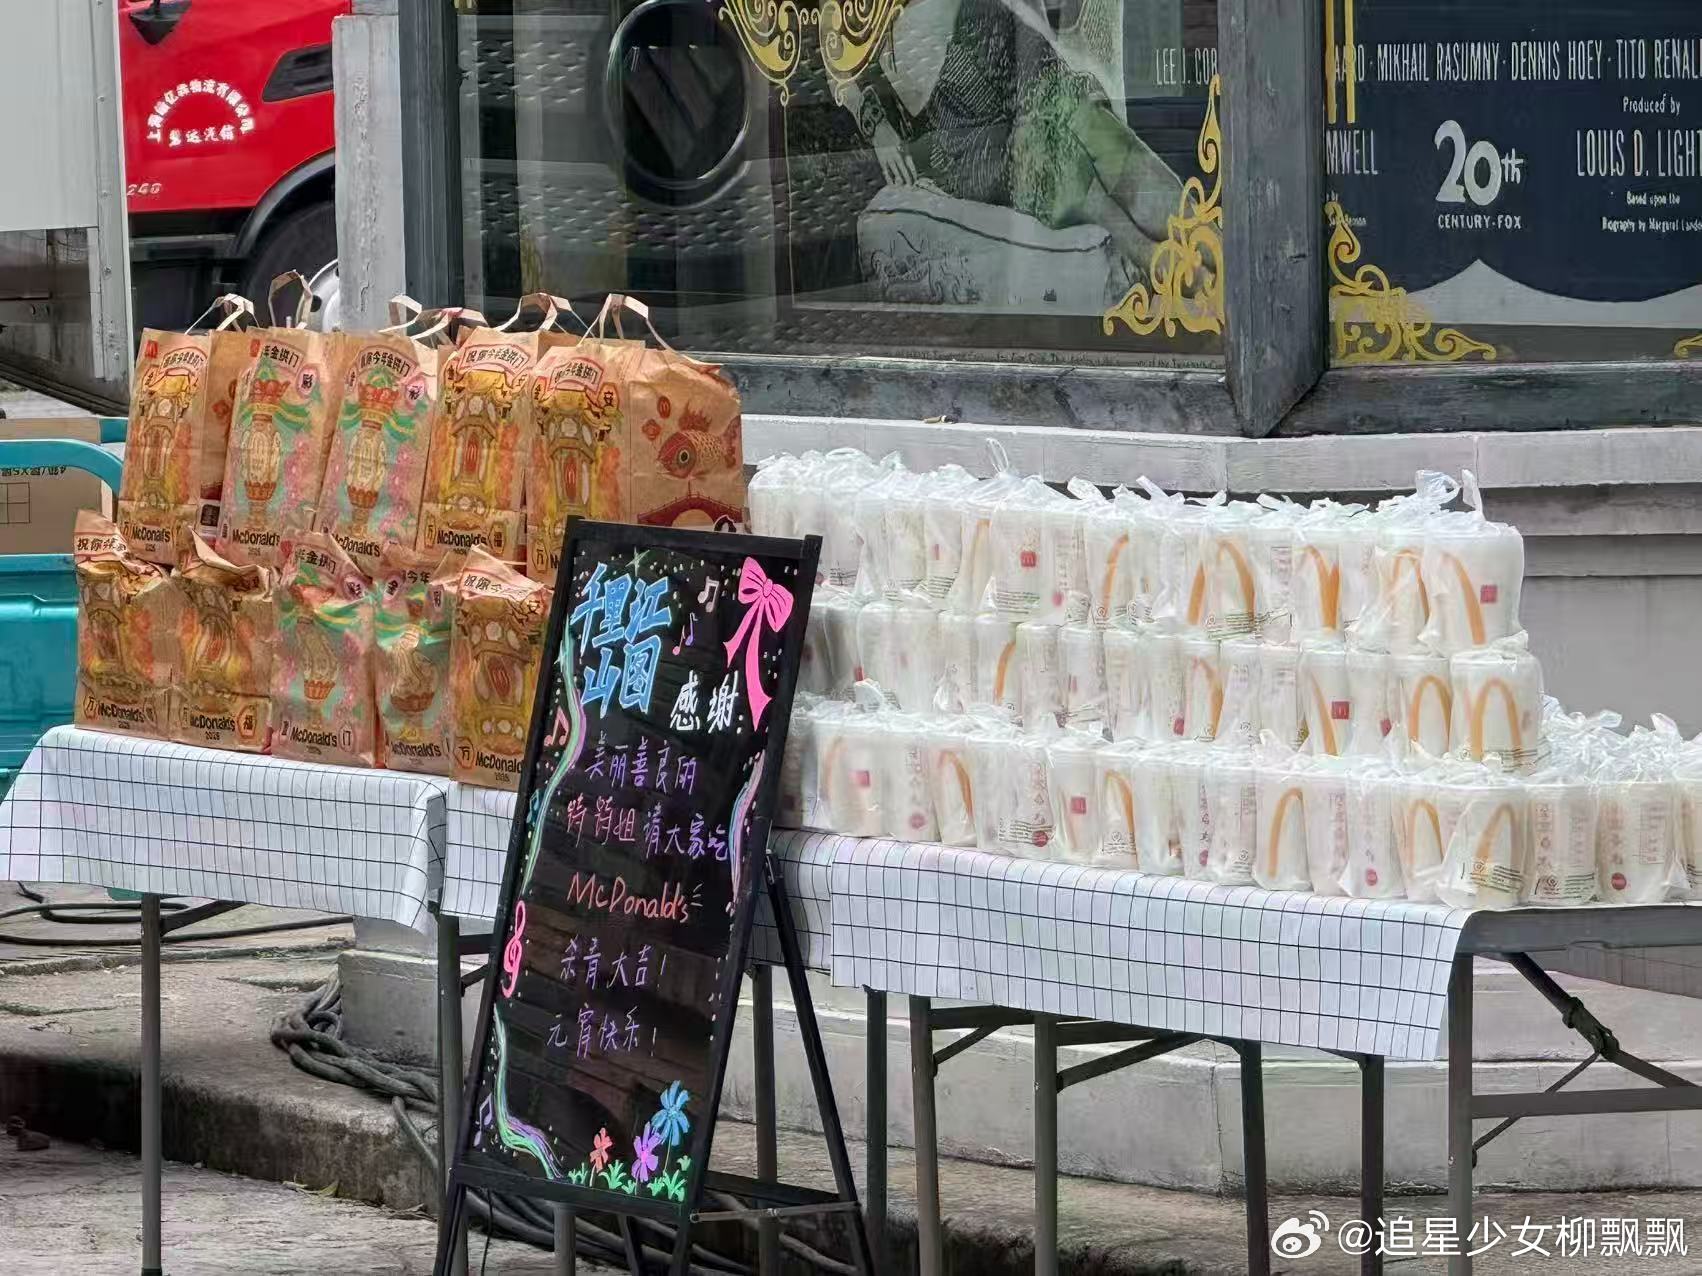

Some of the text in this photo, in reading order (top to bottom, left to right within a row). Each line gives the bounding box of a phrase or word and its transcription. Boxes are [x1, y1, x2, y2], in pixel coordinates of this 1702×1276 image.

[1156, 48, 1176, 85] LEE
[1377, 44, 1430, 81] MIKHAIL
[1436, 43, 1500, 81] RASUMNY
[1511, 41, 1560, 81] DENNIS
[1568, 40, 1602, 80] HOEY
[1616, 38, 1646, 79] TITO
[1655, 38, 1702, 79] RENAL
[1623, 94, 1681, 115] Produced by
[1434, 119, 1524, 206] 20th
[1577, 129, 1625, 177] LOUIS
[1633, 129, 1649, 177] D.
[570, 561, 672, 657] 千里江
[581, 634, 662, 719] 山图
[290, 726, 338, 748] McDonald's
[567, 871, 689, 924] McDonald's
